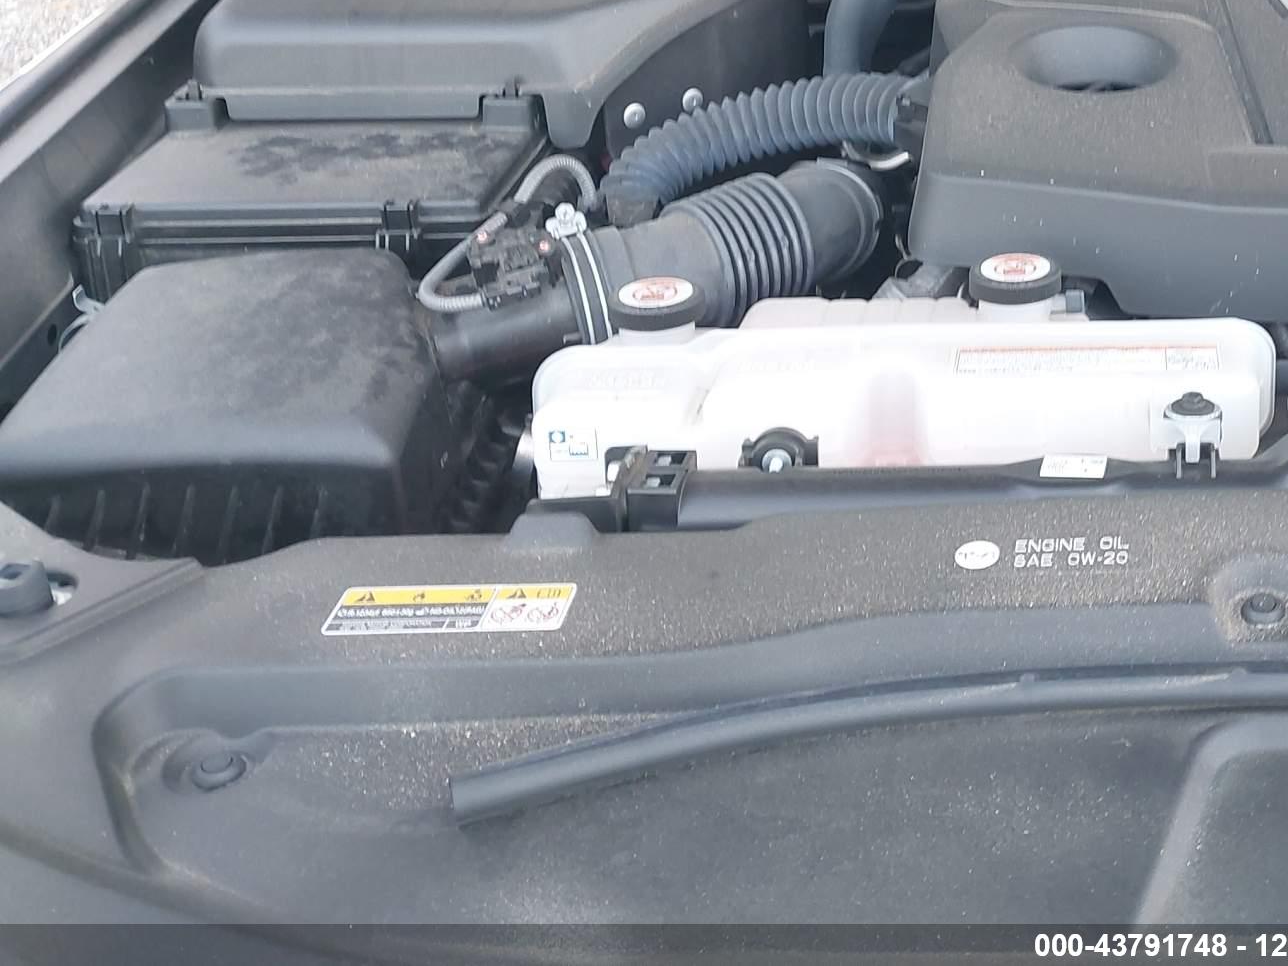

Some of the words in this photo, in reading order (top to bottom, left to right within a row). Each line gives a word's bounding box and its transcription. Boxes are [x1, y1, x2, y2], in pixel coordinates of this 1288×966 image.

[1014, 537, 1086, 553] ENGINE
[1099, 535, 1130, 550] OIL
[1013, 553, 1054, 568] SAE
